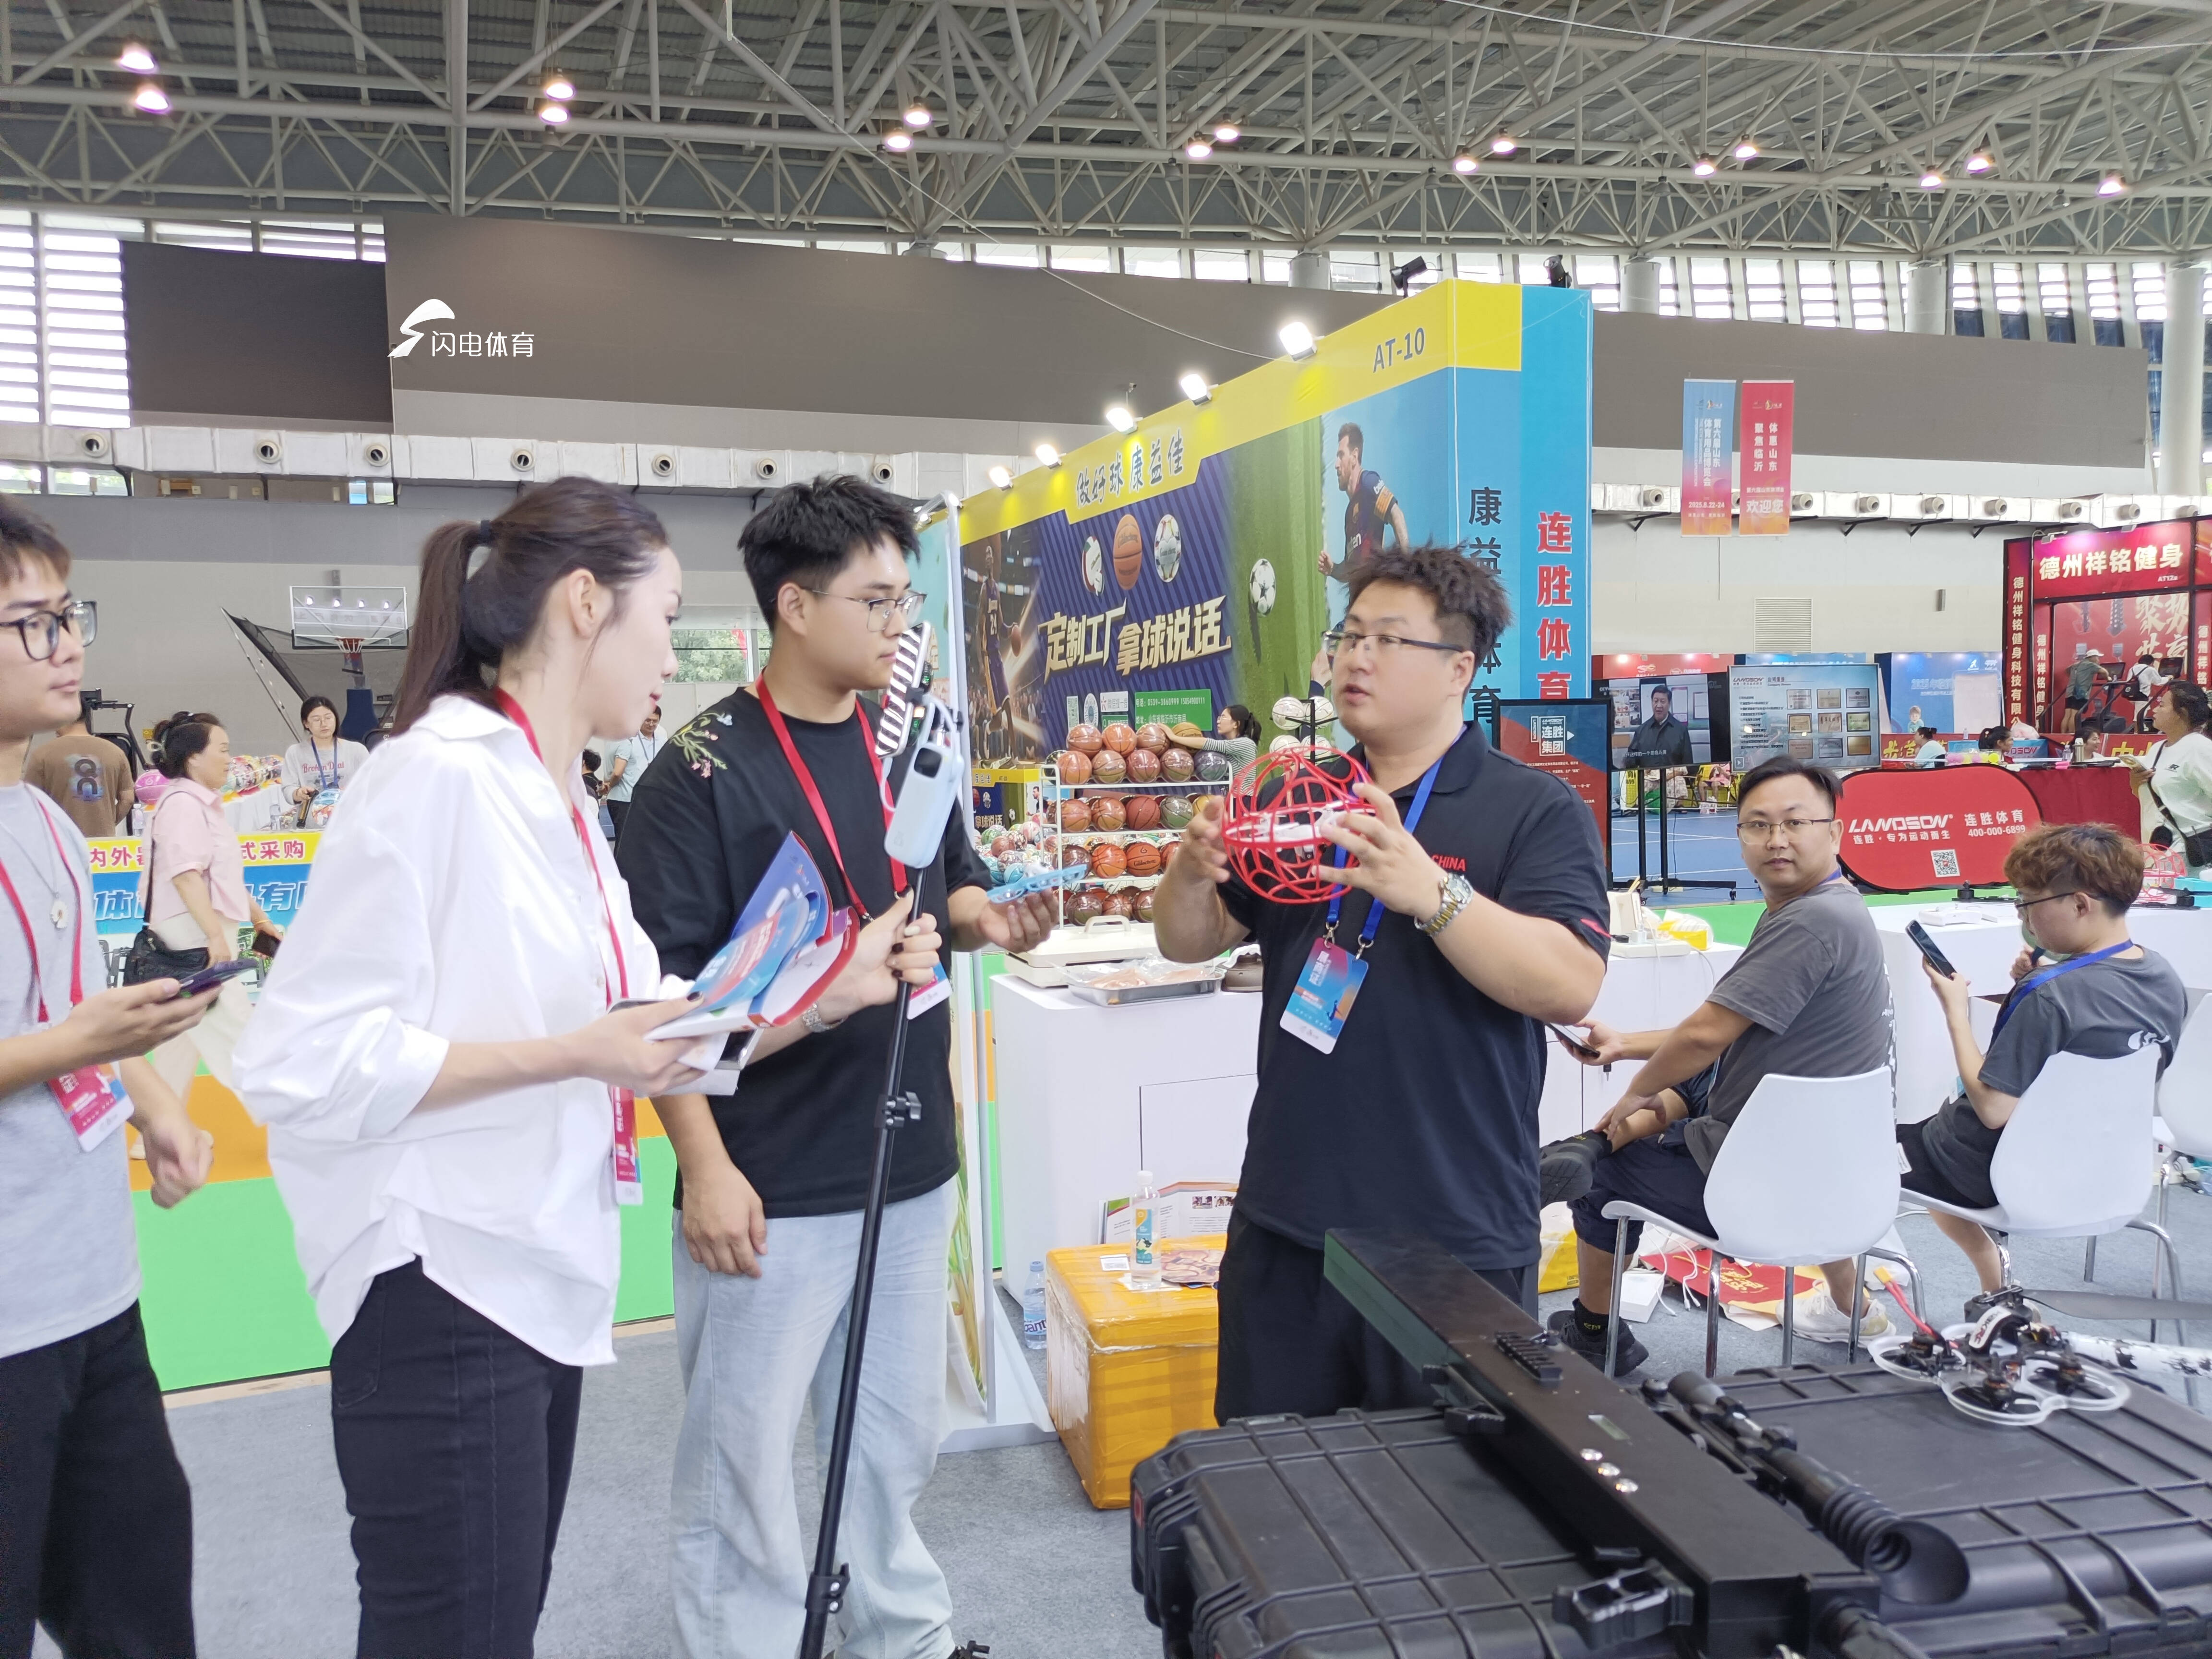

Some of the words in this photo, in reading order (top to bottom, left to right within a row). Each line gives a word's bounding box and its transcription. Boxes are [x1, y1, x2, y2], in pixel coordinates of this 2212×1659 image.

[1373, 327, 1424, 373] AT-10
[1746, 499, 1784, 514] 欢迎您
[2039, 543, 2183, 580] 德州祥铭健身
[990, 613, 998, 636] 24
[1038, 597, 1127, 684] 定制工厂
[1116, 595, 1232, 676] 拿球说话
[1541, 725, 1563, 738] 连胜
[1541, 740, 1563, 754] 集团
[327, 761, 345, 770] Dal
[1964, 809, 2024, 827] 连胜体育
[1968, 825, 2026, 838] 400-000-6899
